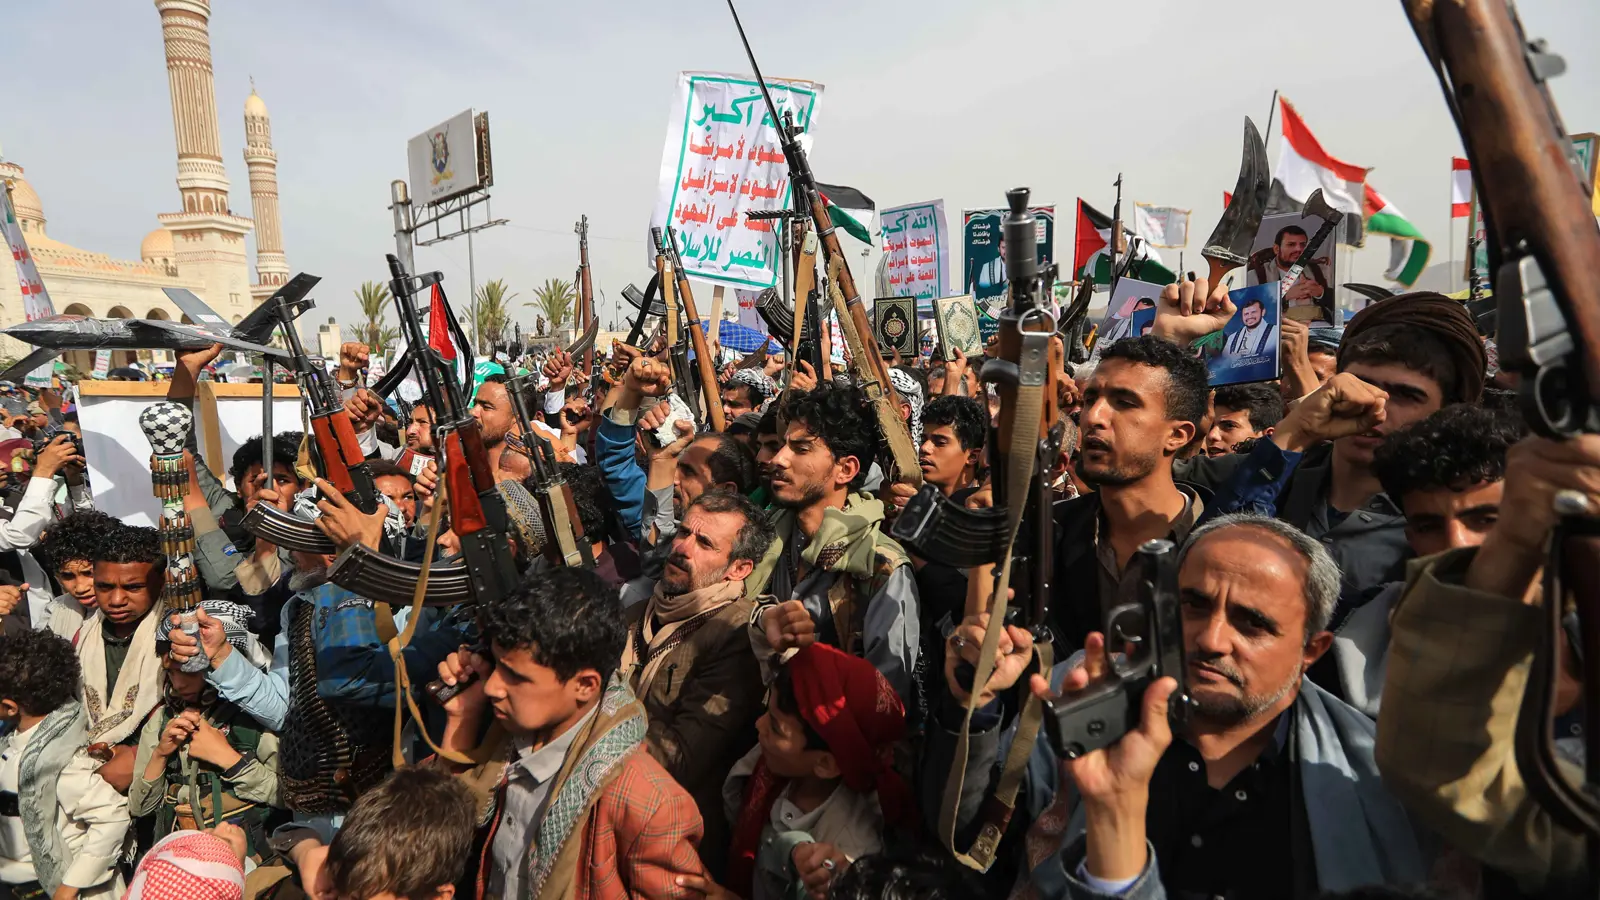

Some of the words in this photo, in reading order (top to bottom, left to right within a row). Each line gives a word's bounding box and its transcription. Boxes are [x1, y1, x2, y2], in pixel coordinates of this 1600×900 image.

[692, 89, 763, 132] أكبر
[689, 132, 745, 161] لأمريكا
[681, 167, 739, 200] لإسرائيل
[740, 178, 786, 201] الموت
[674, 202, 715, 228] اليهود
[715, 207, 738, 230] على
[912, 212, 933, 229] الله
[680, 230, 721, 268] للإسلا
[910, 233, 935, 249] الموت
[721, 239, 772, 271] النصر
[911, 251, 936, 267] الموت
[918, 268, 936, 281] اللعنة
